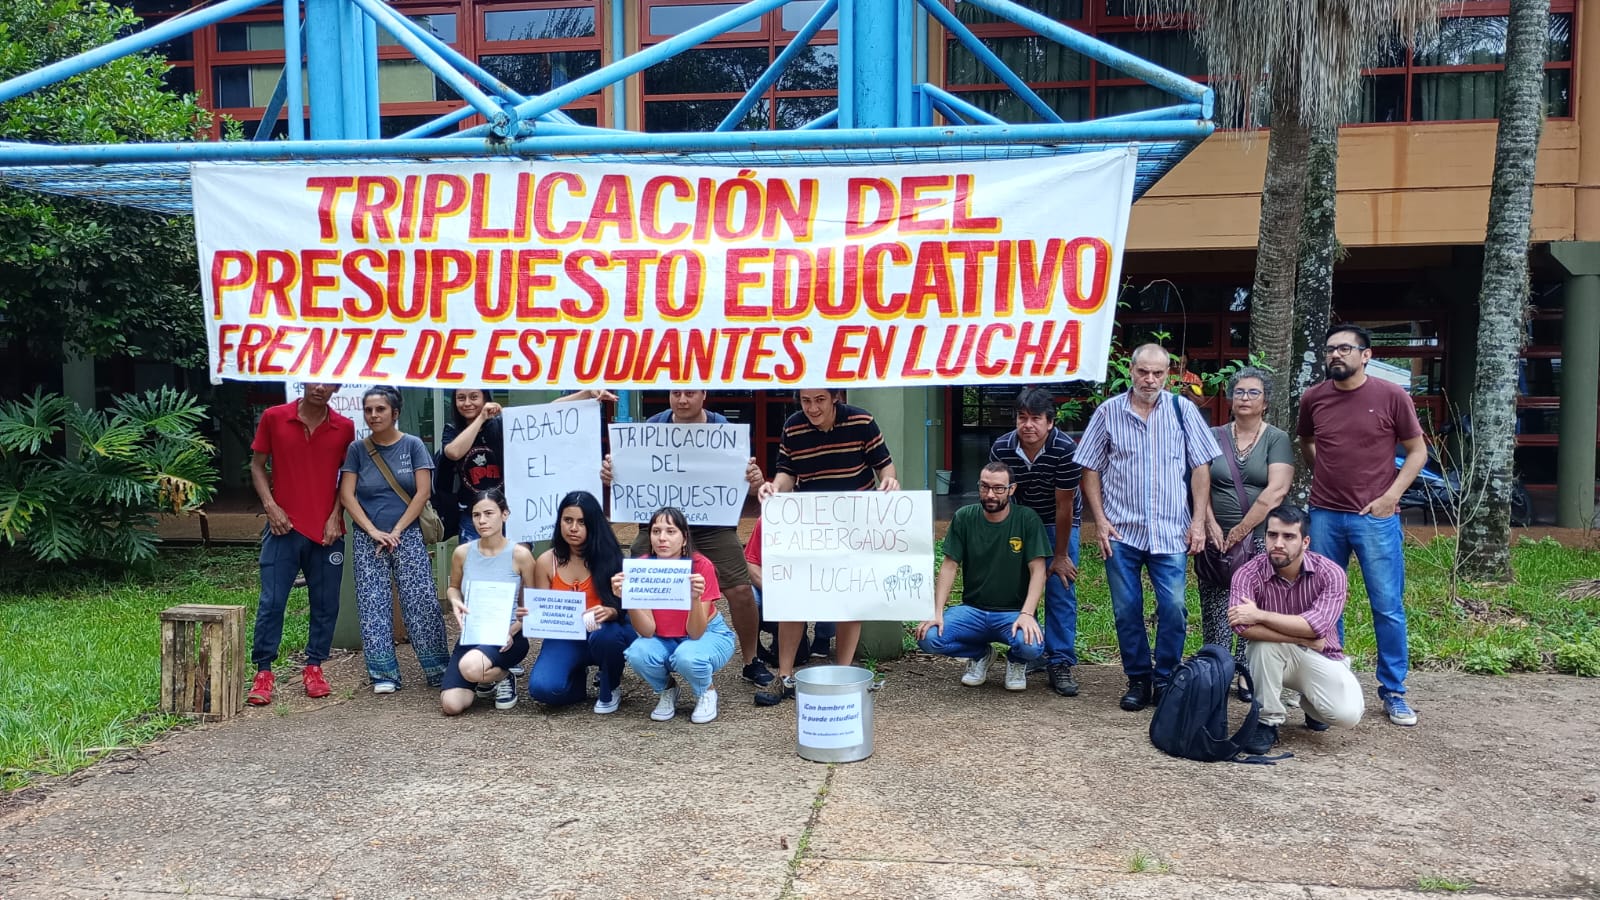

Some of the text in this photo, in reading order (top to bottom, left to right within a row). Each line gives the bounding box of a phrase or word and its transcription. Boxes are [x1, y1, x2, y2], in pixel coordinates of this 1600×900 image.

[306, 169, 1002, 245] TRIPLICACIÓN DEL
[210, 237, 1113, 323] PRESUPUESTO EDUCATIVO
[216, 319, 1084, 383] FRENTE DE ESTUDIANTES EN LUCHA
[509, 407, 580, 442] ABAJO
[611, 424, 737, 450] TRIPLICACIÓN
[527, 454, 556, 478] EL
[651, 454, 687, 473] DEL
[612, 483, 738, 510] PRESUPUESTO
[764, 495, 914, 526] COLECTIVO
[764, 527, 909, 552] DE ALBERGADOS
[772, 563, 879, 593] EN LUCHA
